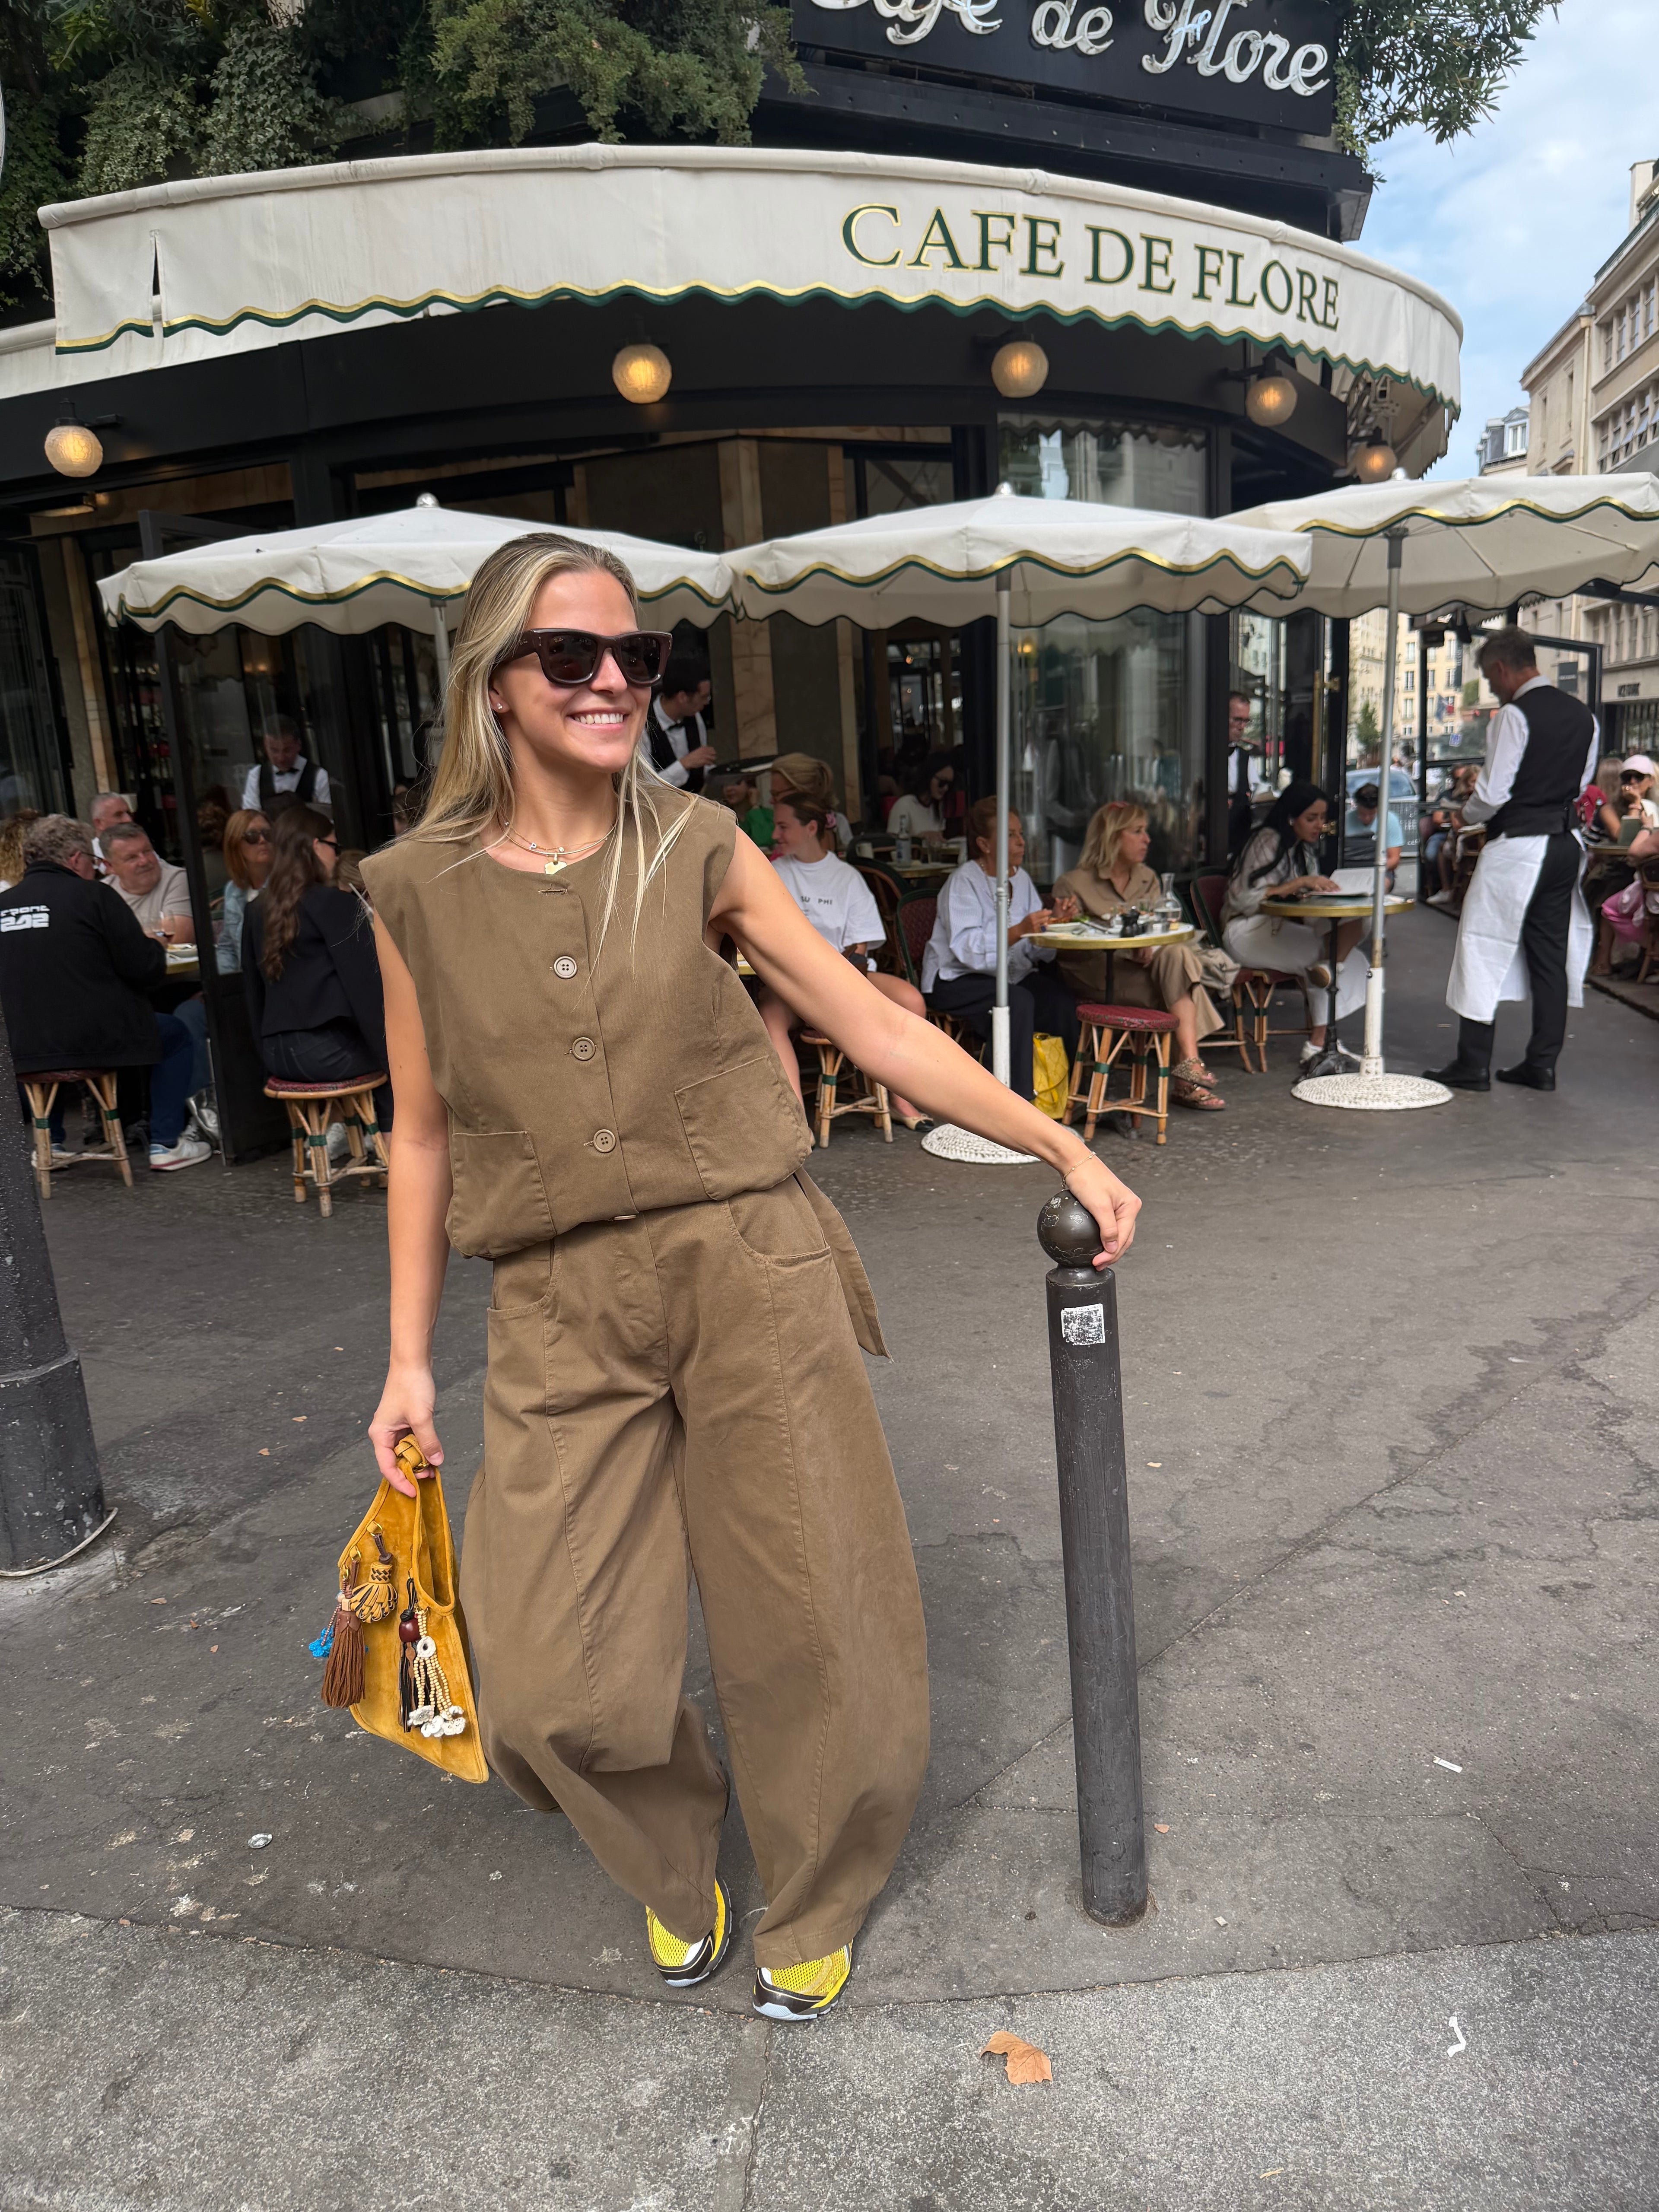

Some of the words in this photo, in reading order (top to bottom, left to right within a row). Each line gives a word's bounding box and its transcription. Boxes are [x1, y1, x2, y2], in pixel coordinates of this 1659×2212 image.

[1032, 0, 1114, 55] de
[1141, 0, 1330, 96] Flore
[840, 202, 1065, 280] CAFE
[1084, 224, 1176, 296] DE
[1192, 243, 1339, 332] FLORE
